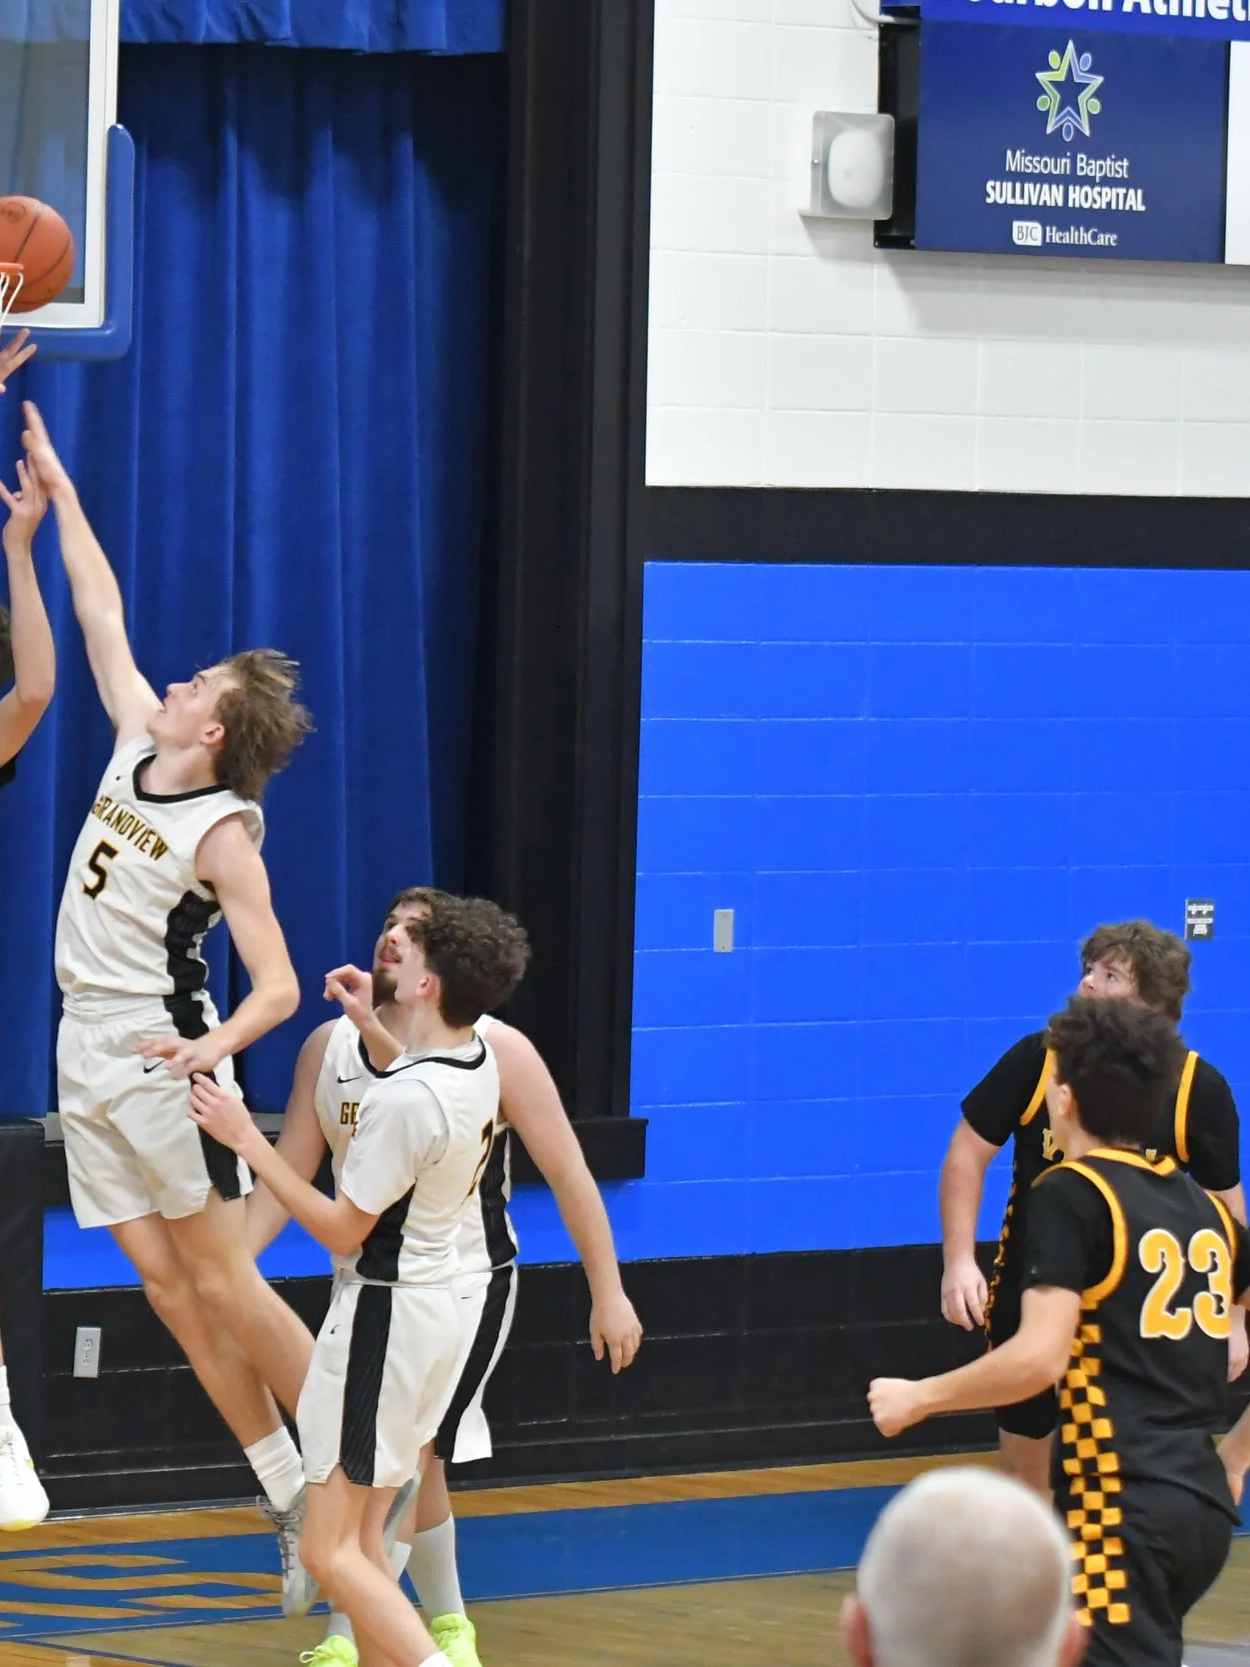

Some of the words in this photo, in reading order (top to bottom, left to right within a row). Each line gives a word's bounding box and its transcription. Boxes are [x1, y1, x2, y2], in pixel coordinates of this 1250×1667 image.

[1005, 149, 1071, 175] Missouri
[1076, 152, 1129, 183] Baptist
[985, 179, 1063, 207] SULLIVAN
[1068, 183, 1146, 211] HOSPITAL
[1016, 225, 1039, 243] BJC
[1045, 225, 1118, 246] HealthCare
[91, 794, 168, 861] GRANDVIEW
[83, 838, 119, 901] 5
[1138, 1228, 1231, 1339] 23
